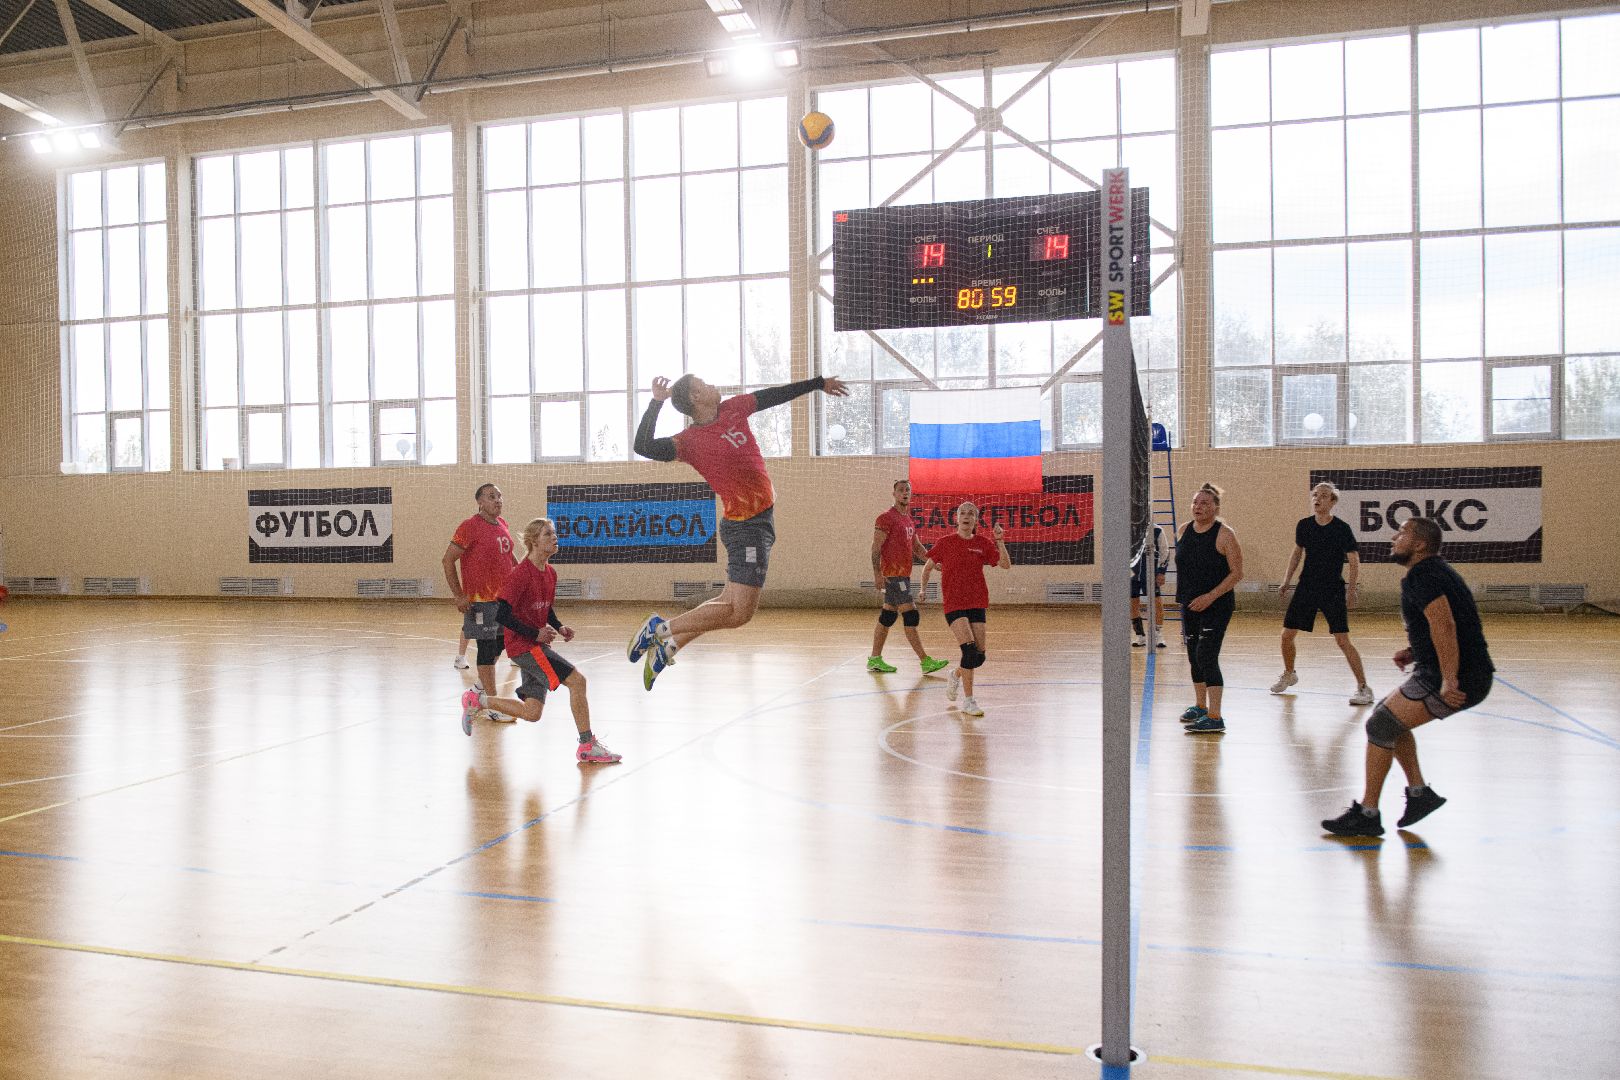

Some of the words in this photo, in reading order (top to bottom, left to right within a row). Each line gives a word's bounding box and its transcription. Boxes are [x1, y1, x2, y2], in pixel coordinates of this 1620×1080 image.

[968, 233, 1005, 244] ПЕРИОД
[1045, 234, 1069, 260] 14
[922, 243, 945, 267] 14
[972, 278, 1002, 287] ВРЕМЯ
[1038, 287, 1066, 297] ФОЛЫ
[910, 295, 937, 304] ФОЛЫ
[720, 424, 748, 448] 15
[254, 509, 379, 539] ФУТБОЛ
[556, 508, 707, 539] ВОЛЕЙБОЛ
[1360, 498, 1488, 533] БОКС
[496, 535, 511, 553] 13
